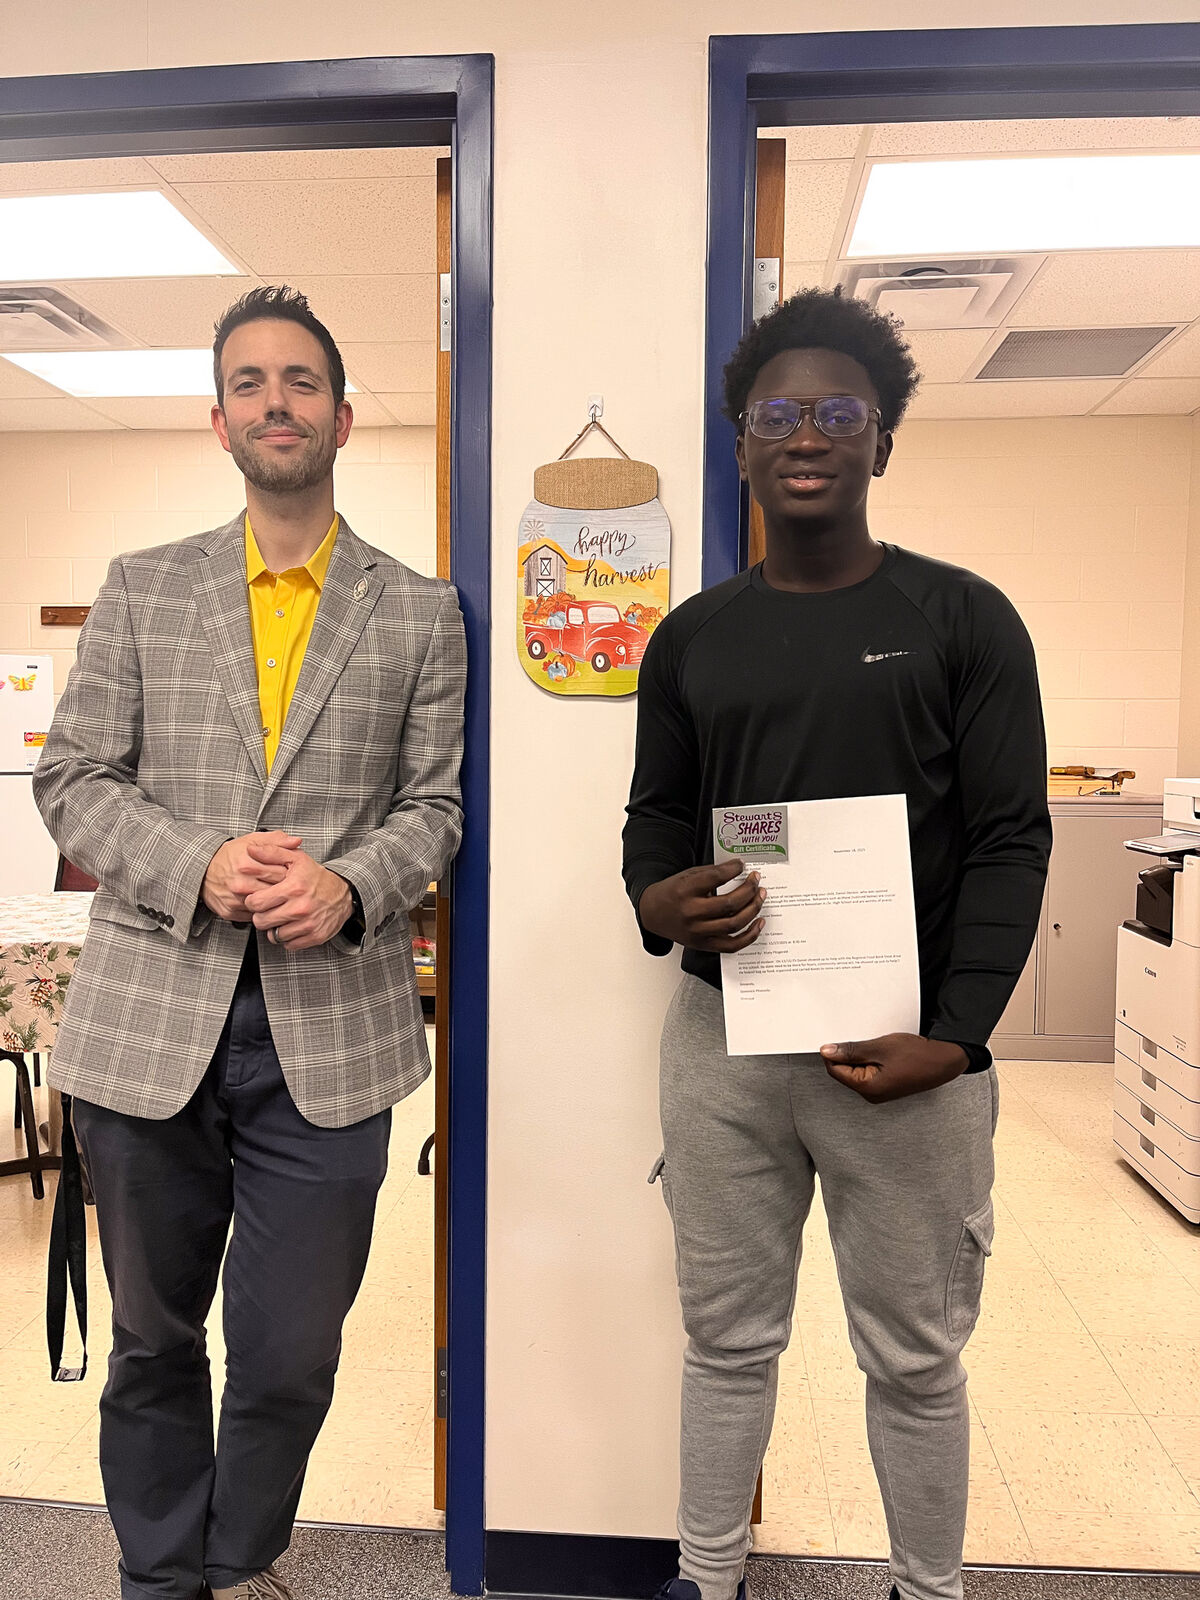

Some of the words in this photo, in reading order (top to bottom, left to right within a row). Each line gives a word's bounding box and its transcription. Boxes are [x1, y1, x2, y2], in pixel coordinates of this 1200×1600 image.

[573, 526, 636, 557] happy
[563, 553, 666, 587] harvest
[738, 821, 782, 835] SHARES
[741, 835, 760, 844] WITH
[1144, 966, 1157, 978] Canon
